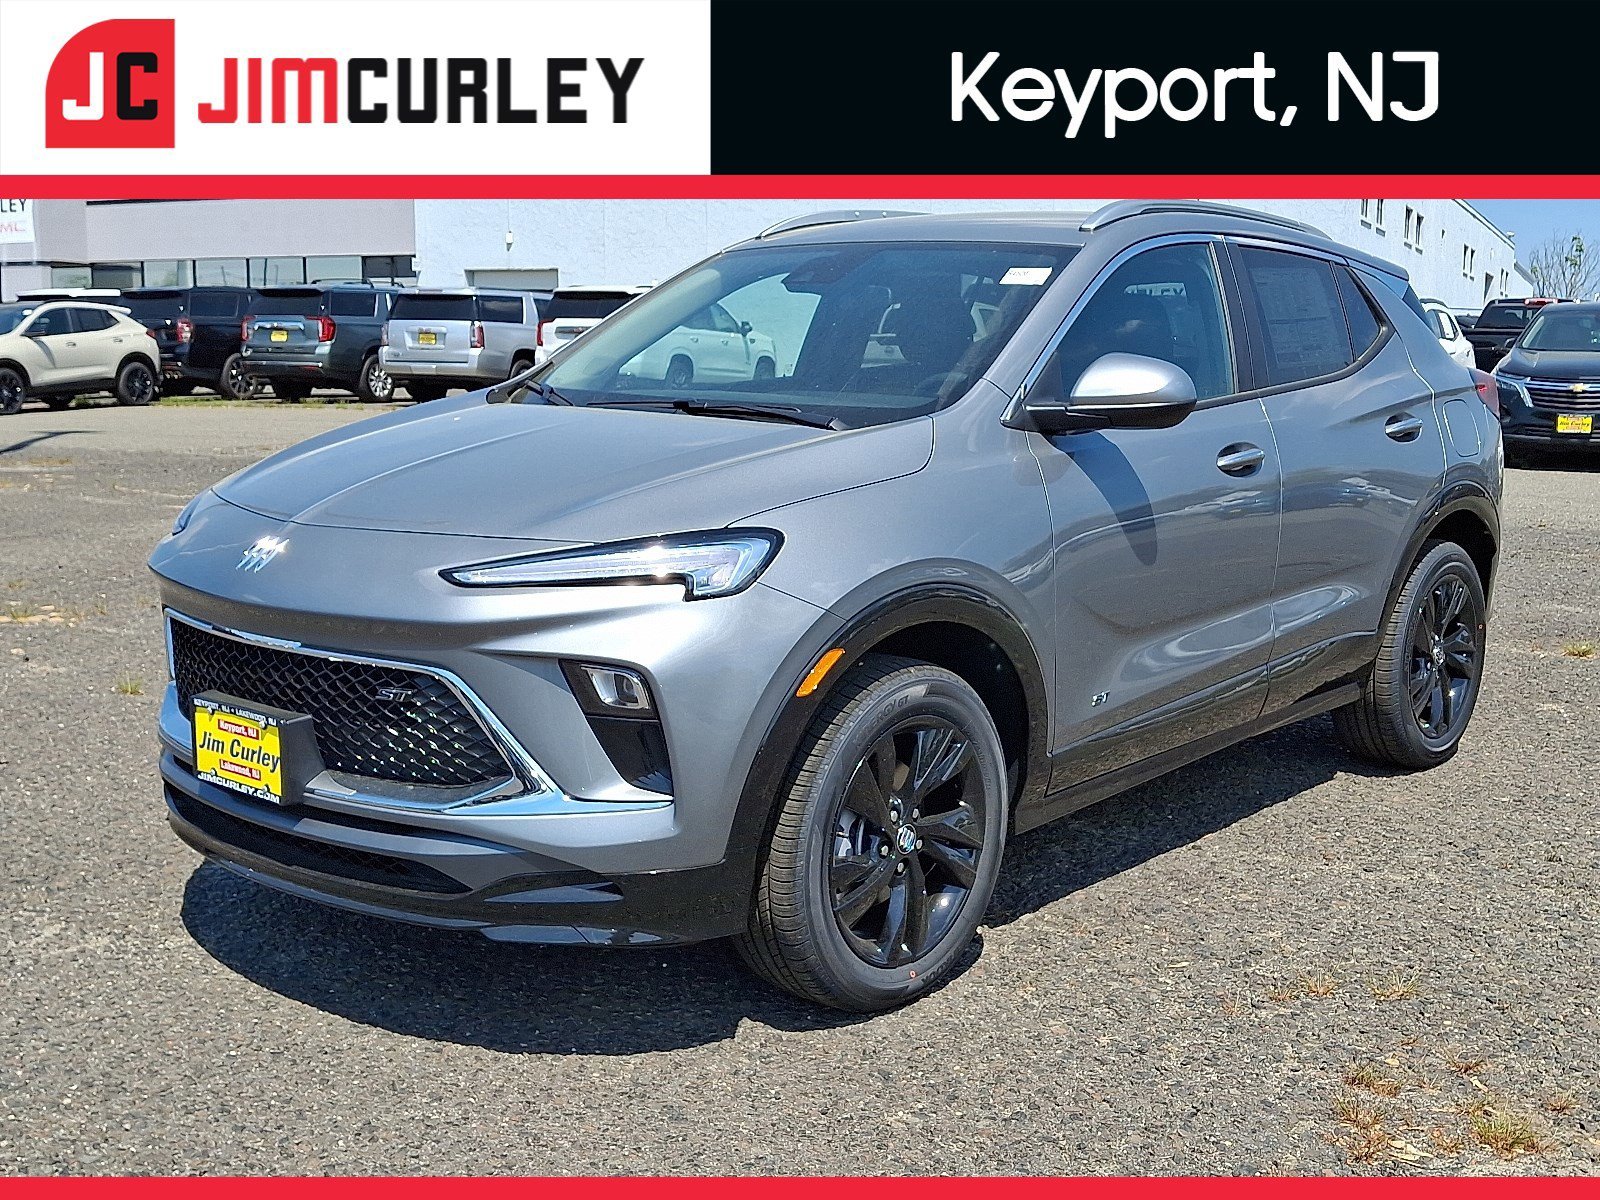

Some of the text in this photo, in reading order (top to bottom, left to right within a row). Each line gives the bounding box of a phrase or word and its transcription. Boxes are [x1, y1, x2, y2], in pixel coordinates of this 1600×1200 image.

[219, 720, 257, 738] Keyport, NJ
[199, 731, 280, 773] Jim Curley
[197, 772, 280, 804] JIMCURLEY.COM
